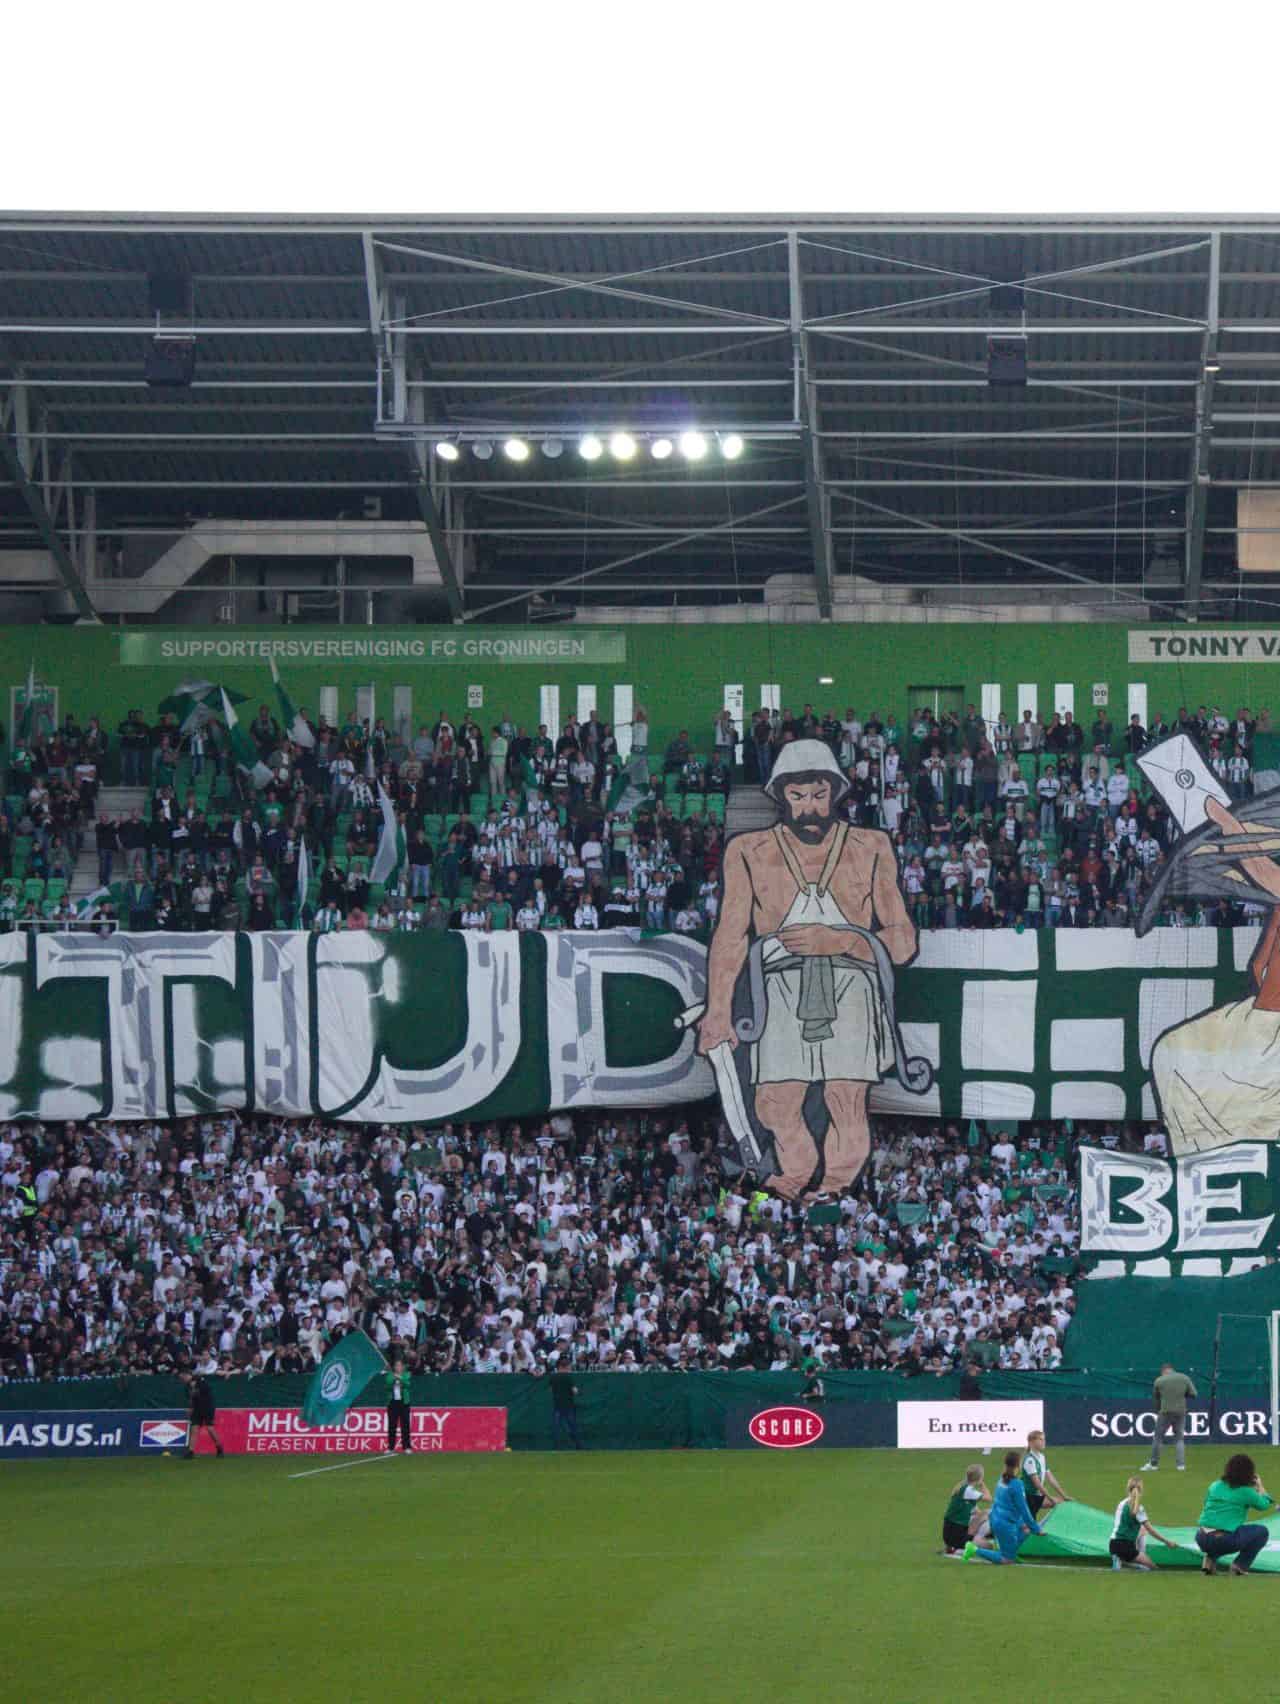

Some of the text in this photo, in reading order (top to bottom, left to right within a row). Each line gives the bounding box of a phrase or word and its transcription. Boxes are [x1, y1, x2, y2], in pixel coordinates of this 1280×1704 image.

[161, 639, 586, 657] SUPPORTERSVERENIGING FC GRONINGEN
[1149, 636, 1249, 657] TONNY
[758, 1418, 813, 1437] SCORE
[928, 1417, 1017, 1433] En meer..
[247, 1438, 317, 1451] LEASEN
[325, 1437, 373, 1451] LEUK
